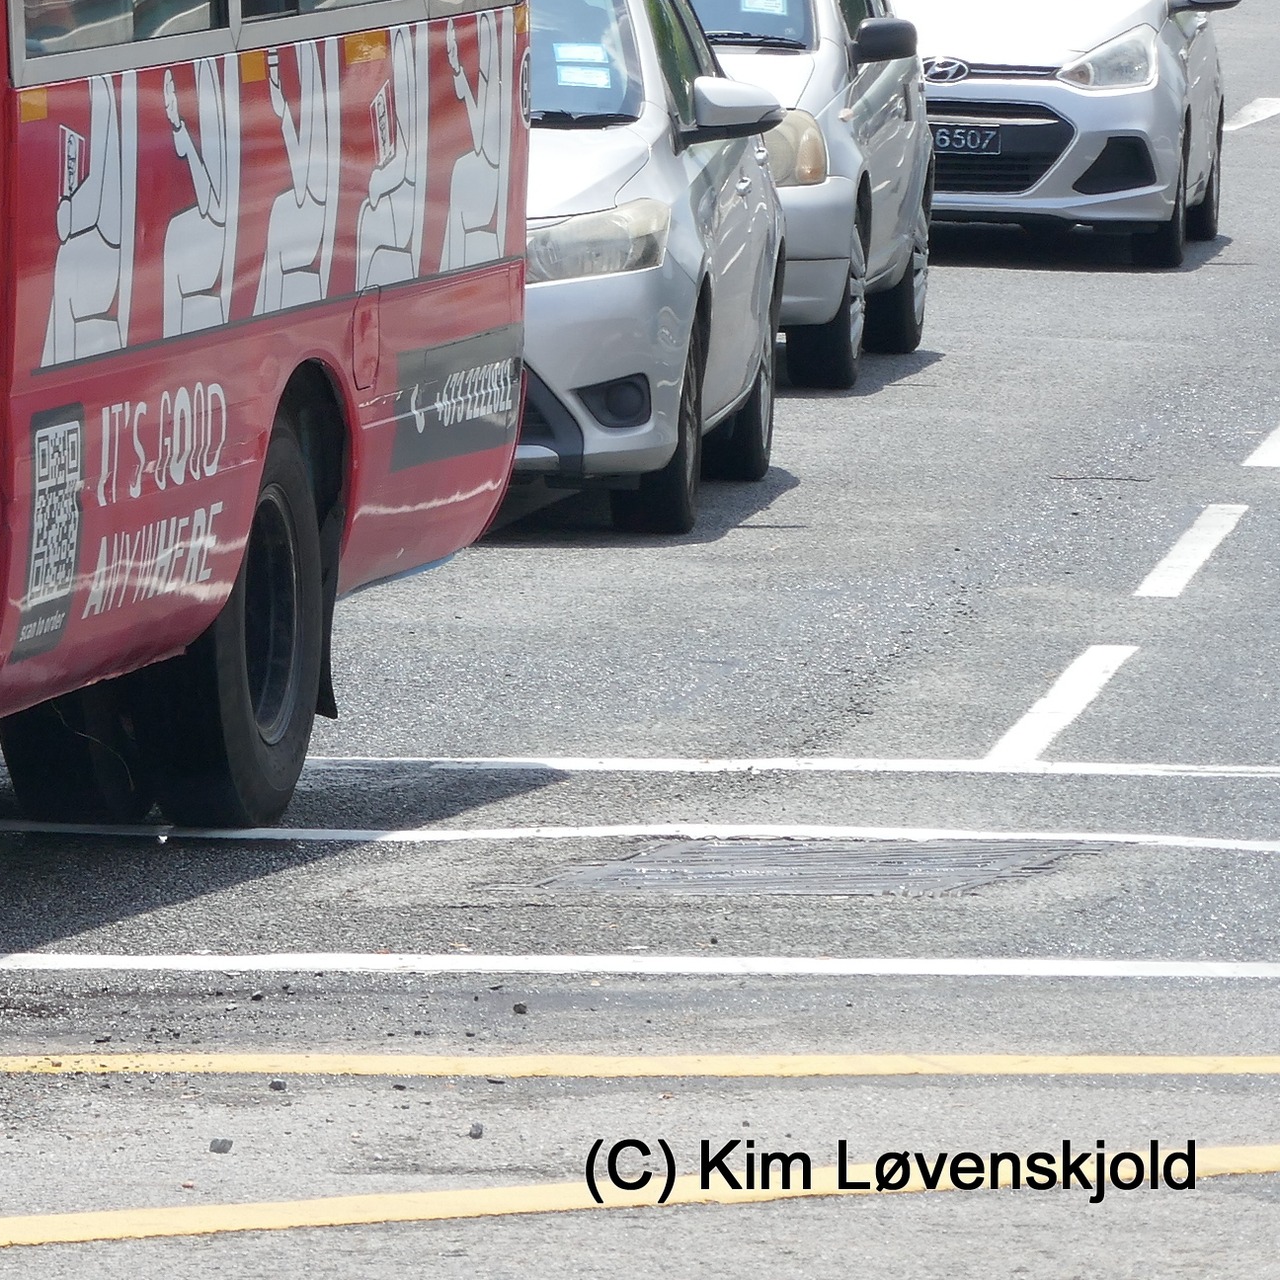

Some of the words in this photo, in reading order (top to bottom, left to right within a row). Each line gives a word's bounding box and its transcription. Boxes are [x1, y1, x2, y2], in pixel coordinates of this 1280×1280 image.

[935, 128, 997, 149] 6507
[97, 400, 147, 507] IT'S
[155, 382, 227, 491] GOOD
[81, 501, 223, 620] ANYWHERE
[18, 622, 38, 642] scan
[43, 609, 66, 634] order
